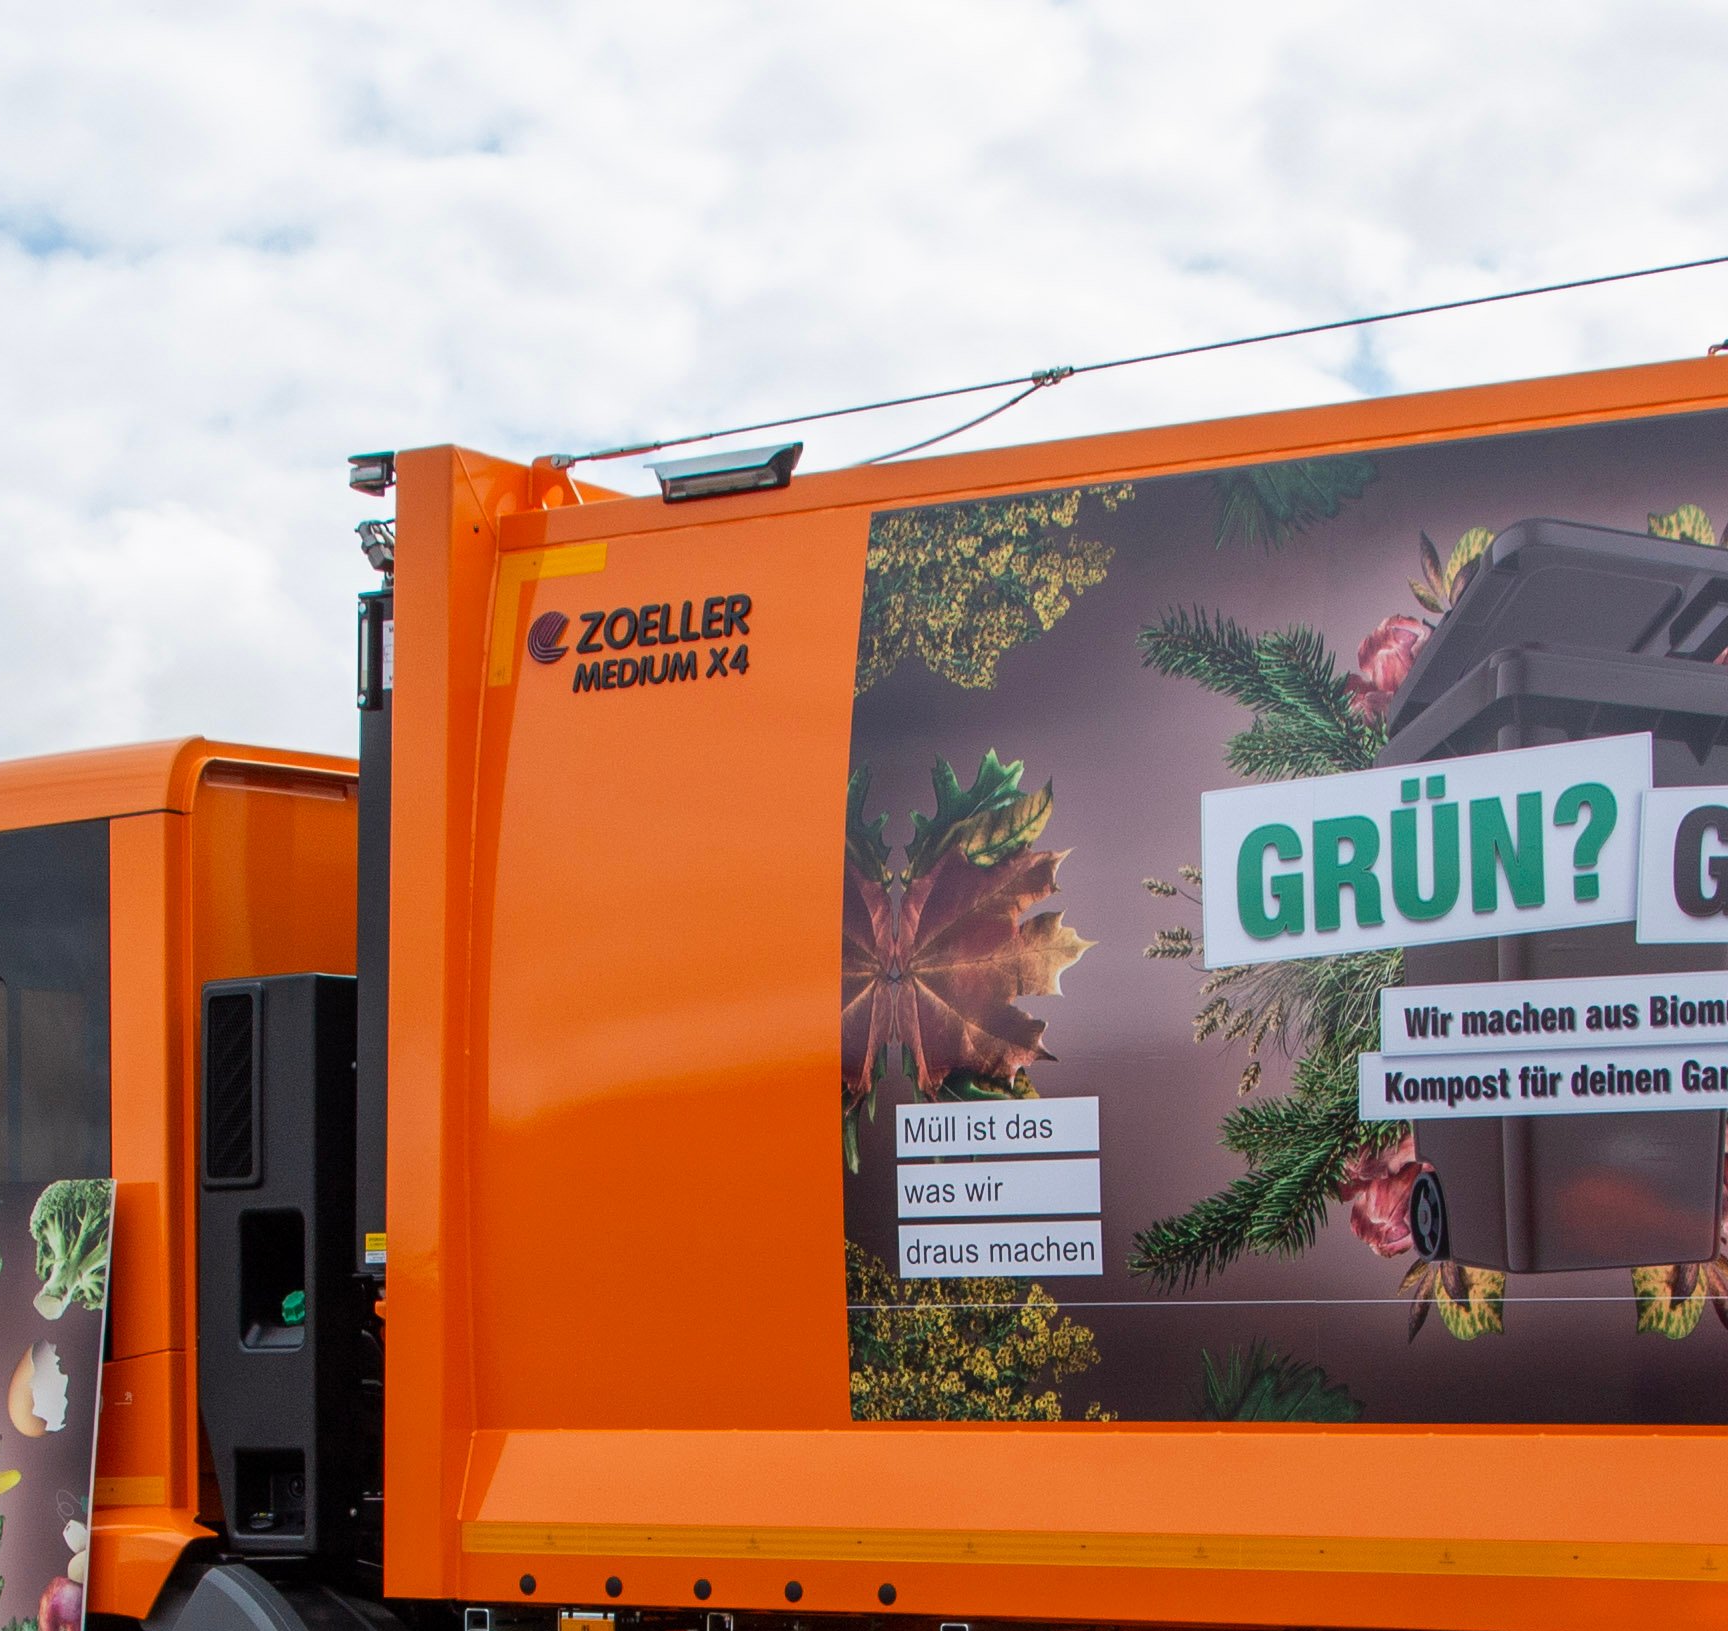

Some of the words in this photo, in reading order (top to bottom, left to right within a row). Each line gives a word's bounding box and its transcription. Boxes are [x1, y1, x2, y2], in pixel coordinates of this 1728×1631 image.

[578, 593, 751, 654] ZOELLER
[572, 652, 698, 693] MEDIUM
[705, 644, 749, 678] X4
[1237, 774, 1618, 940] GRÜN?
[1404, 1005, 1453, 1038] Wir
[1461, 1002, 1577, 1036] machen
[1585, 1005, 1641, 1030] aus
[1384, 1068, 1512, 1106] Kompost
[1518, 1065, 1561, 1098] für
[1571, 1061, 1672, 1096] deinen
[904, 1117, 958, 1144] Müll
[965, 1115, 996, 1142] ist
[1005, 1114, 1054, 1141] das
[904, 1182, 956, 1203] was
[964, 1177, 1003, 1203] wir
[906, 1238, 979, 1265] draus
[989, 1235, 1095, 1263] machen
